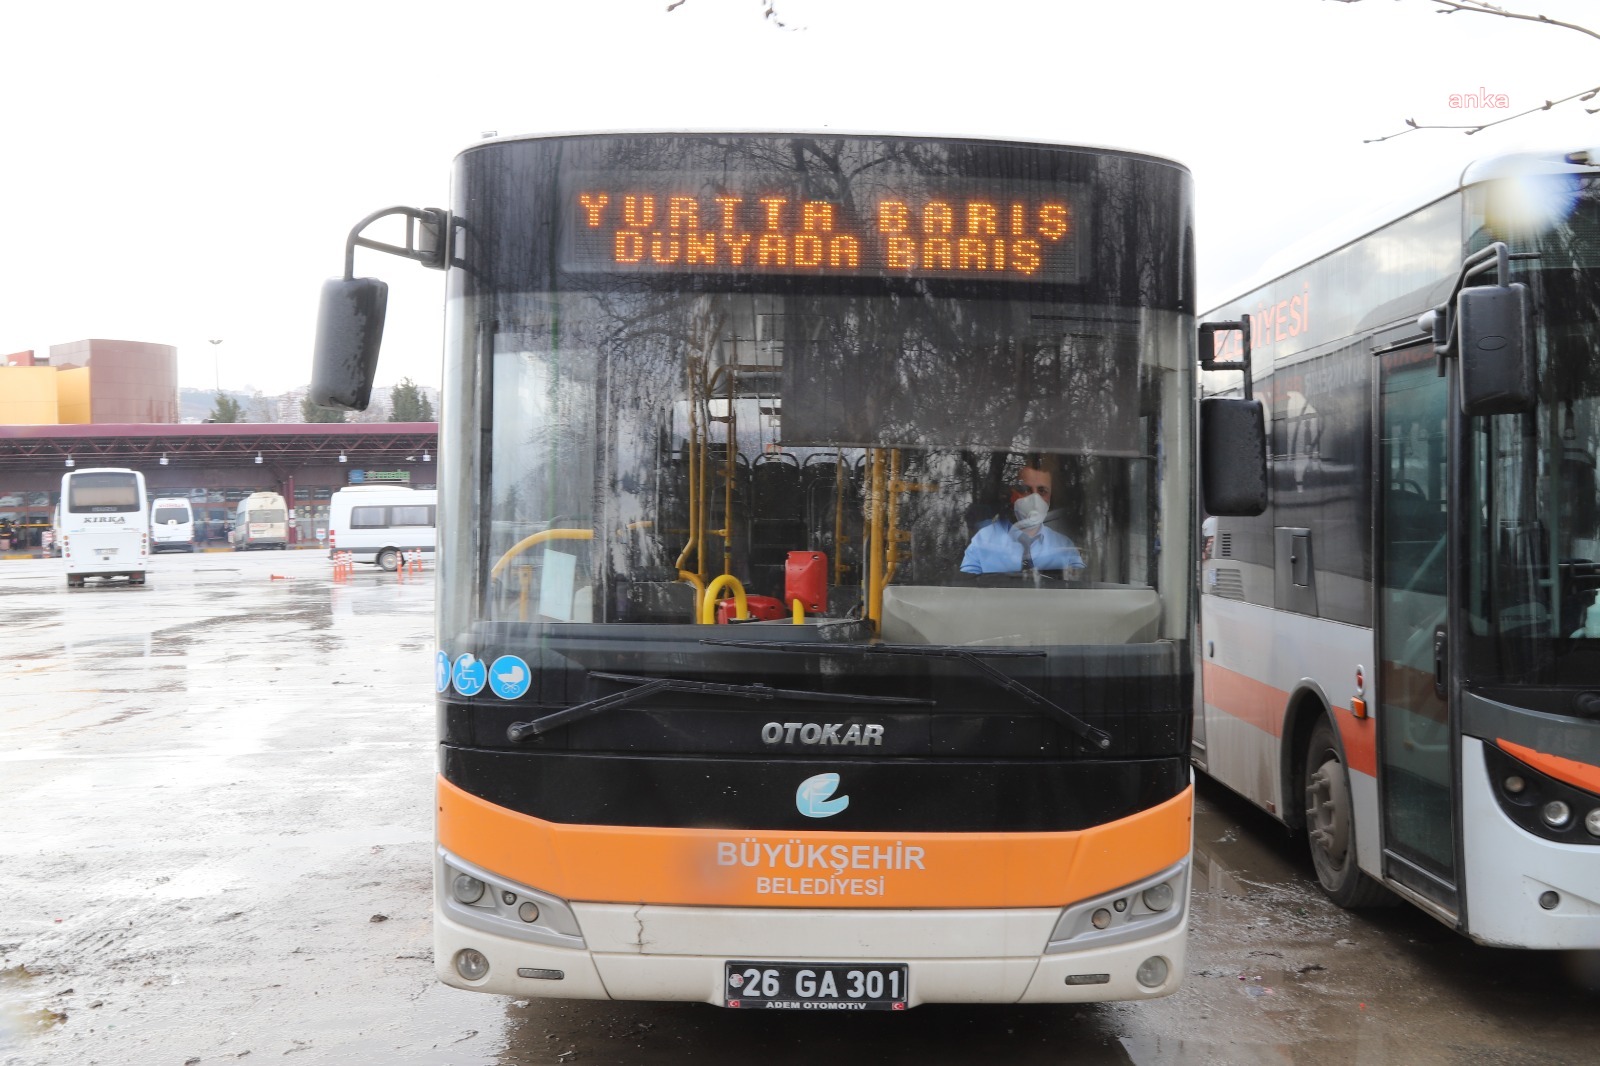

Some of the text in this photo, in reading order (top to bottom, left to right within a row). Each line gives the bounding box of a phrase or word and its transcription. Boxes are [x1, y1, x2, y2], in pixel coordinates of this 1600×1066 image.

[580, 195, 832, 231] YURTTA
[615, 231, 1041, 275] DÜNYADA BARIŞ
[761, 721, 884, 746] OTOKAR
[716, 838, 926, 875] BÜYÜKŞEHİR
[756, 875, 885, 896] BELEDİYESİ
[742, 968, 900, 999] 26 GA 301
[765, 1001, 801, 1009] ADEM
